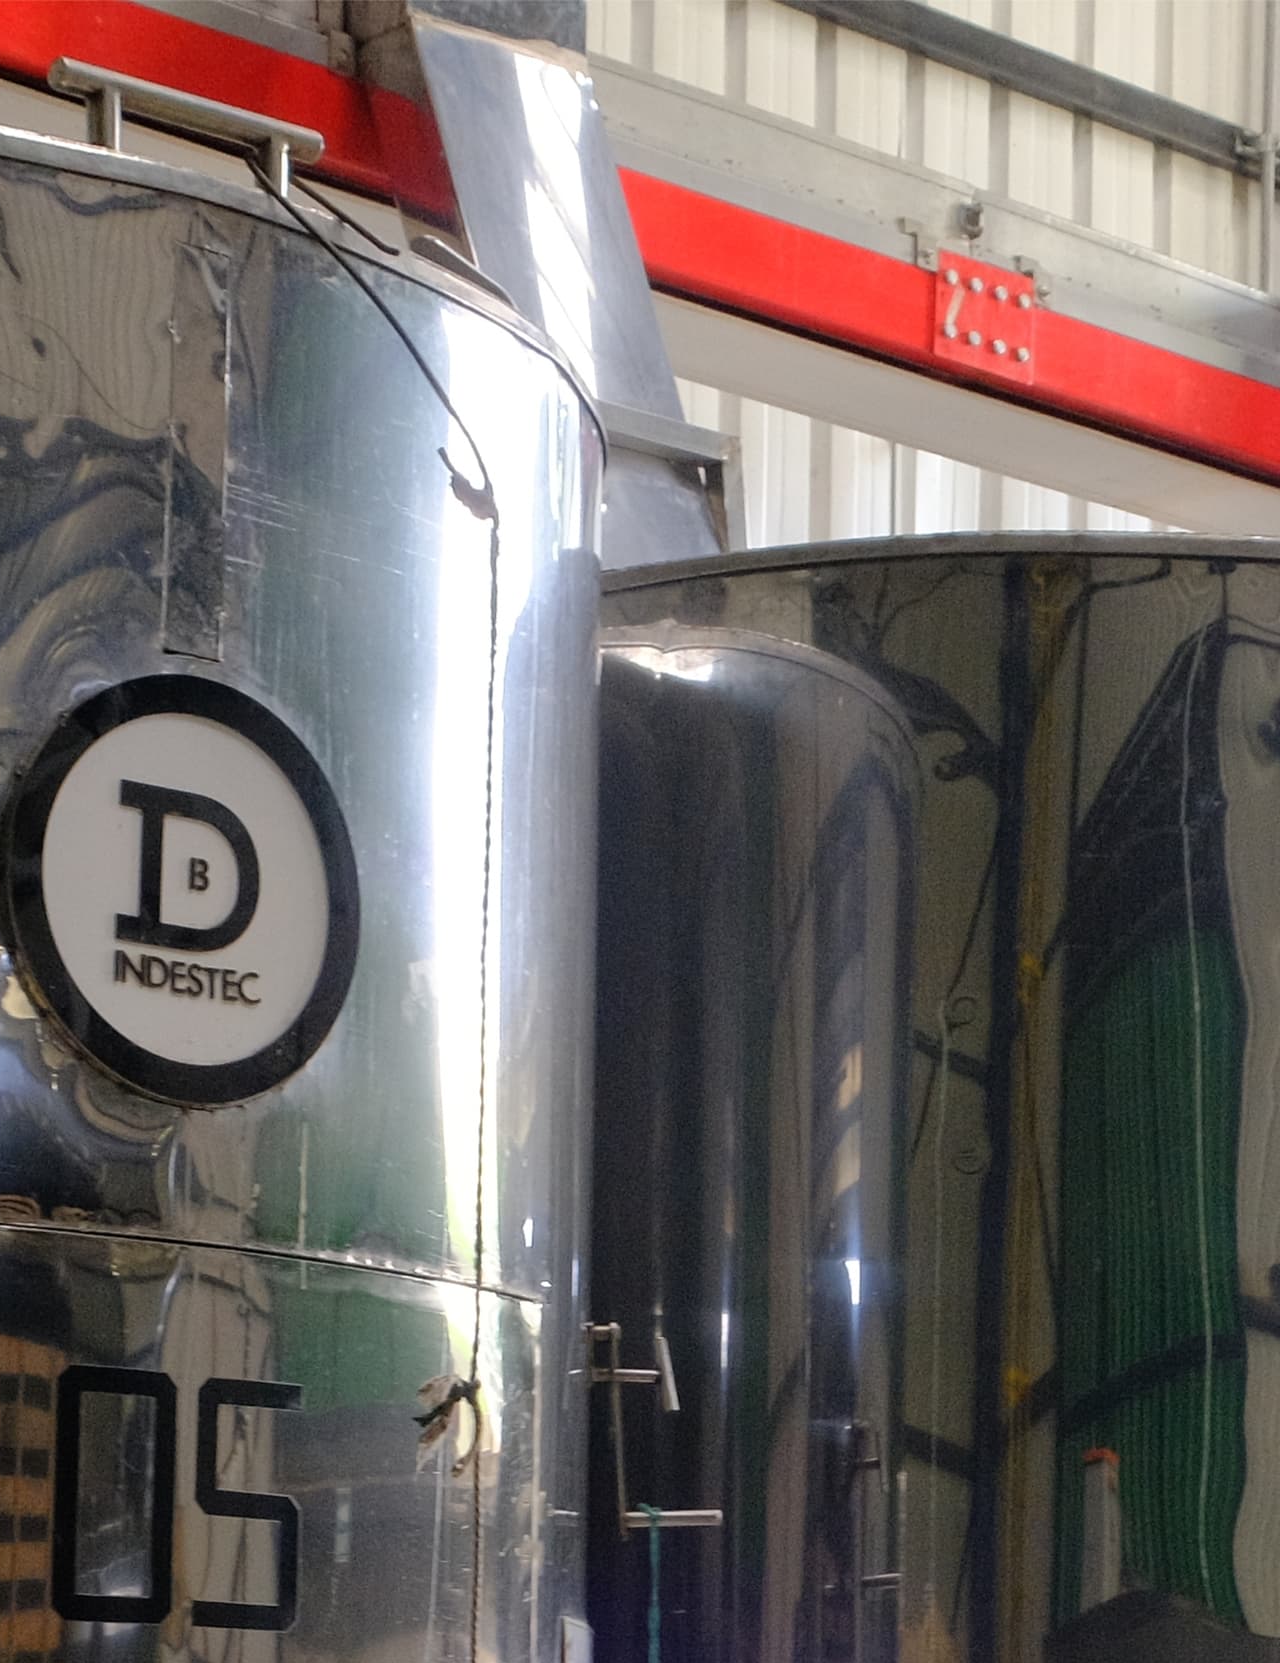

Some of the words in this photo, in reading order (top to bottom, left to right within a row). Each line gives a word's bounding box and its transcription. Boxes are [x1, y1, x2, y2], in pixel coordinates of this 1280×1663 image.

[187, 857, 210, 892] B
[113, 949, 263, 1007] INDESTEC
[51, 1363, 304, 1634] 05
